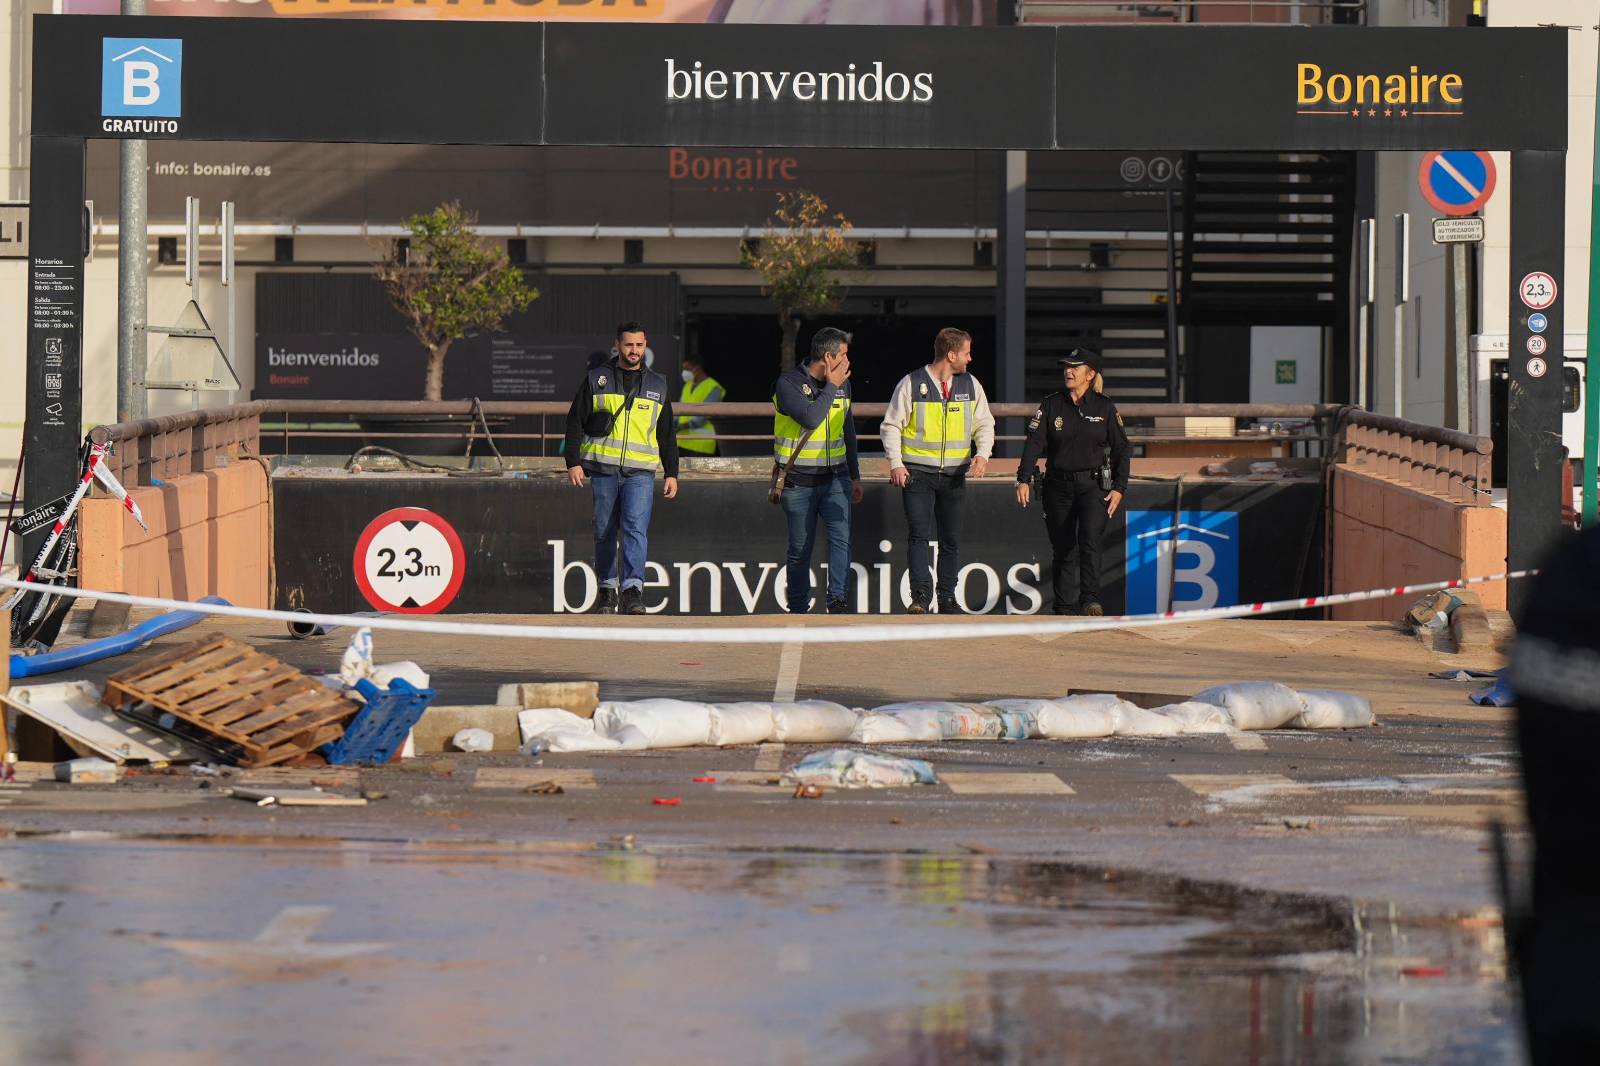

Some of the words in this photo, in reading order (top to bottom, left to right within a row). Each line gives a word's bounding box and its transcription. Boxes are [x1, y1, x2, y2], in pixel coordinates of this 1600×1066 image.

[122, 61, 160, 106] B
[665, 58, 934, 101] bienvenidos
[1297, 63, 1464, 104] Bonaire
[102, 119, 178, 133] GRATUITO
[155, 161, 189, 175] info:
[193, 161, 272, 176] bonaire.es
[668, 148, 798, 180] Bonaire
[1531, 339, 1542, 347] 20
[268, 347, 380, 366] bienvenidos
[270, 374, 310, 385] Bonaire
[17, 505, 57, 530] Bonaire
[1156, 539, 1219, 613] B
